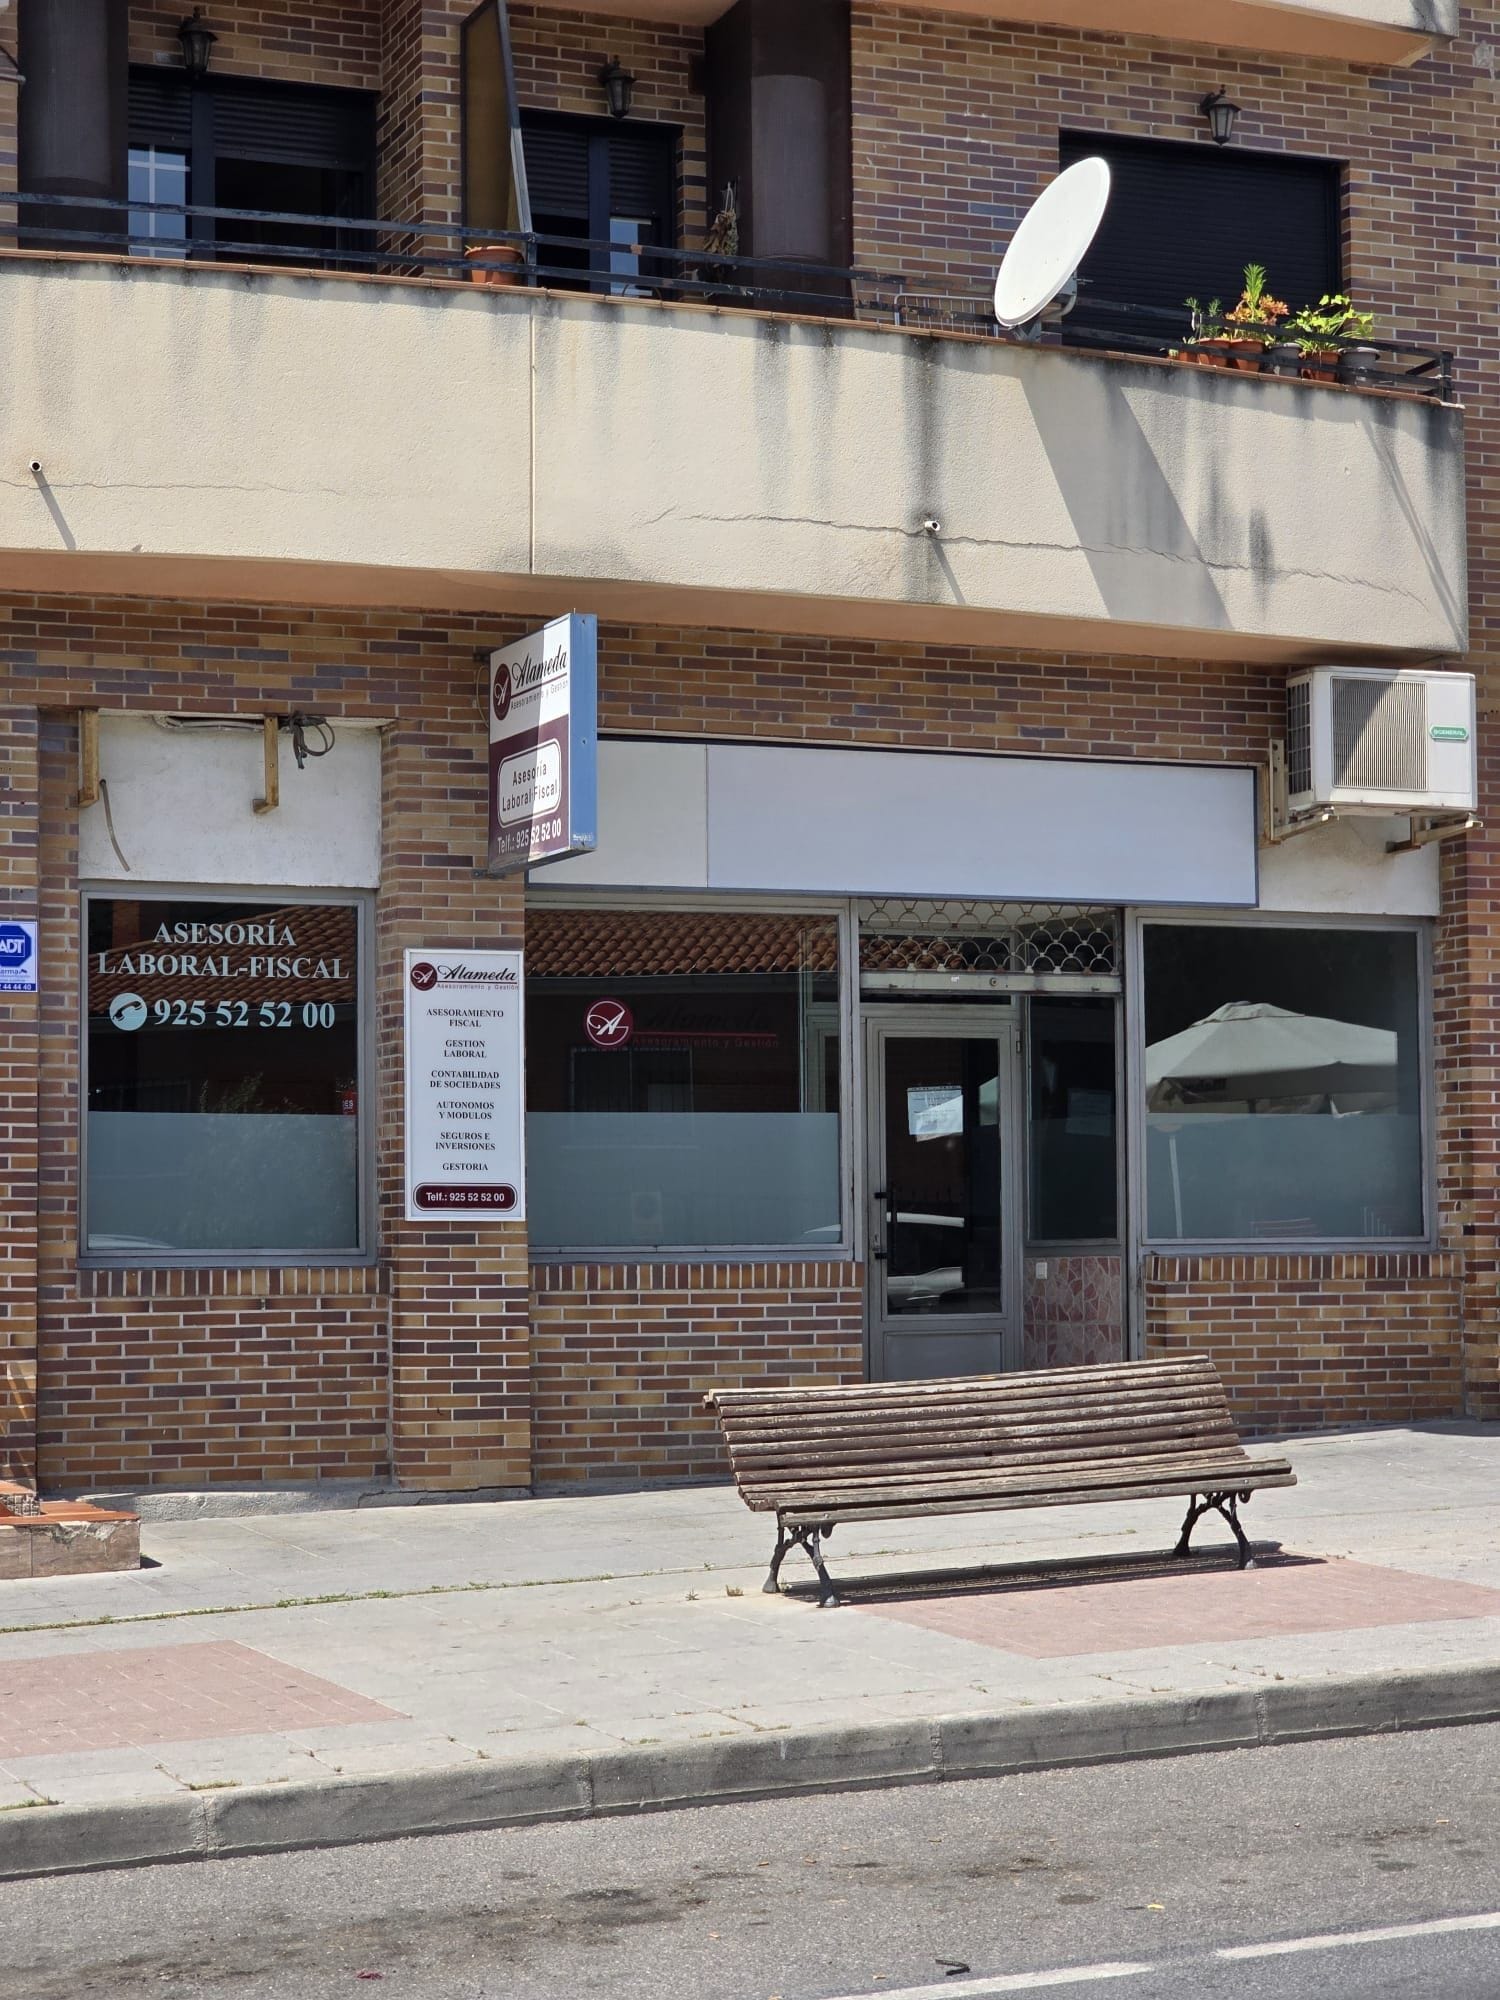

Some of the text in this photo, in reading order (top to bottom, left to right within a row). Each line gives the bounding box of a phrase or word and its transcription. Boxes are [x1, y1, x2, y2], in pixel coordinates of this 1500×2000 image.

[511, 644, 568, 689] Alameda
[512, 760, 547, 787] Asesoría
[497, 835, 515, 854] Telf.:
[516, 828, 529, 849] 925
[530, 824, 540, 845] 52
[541, 820, 550, 842] 52
[551, 818, 561, 838] 00
[152, 919, 297, 946] ASESORÍA
[0, 938, 25, 954] ADT
[97, 952, 350, 979] LABORAL-FISCAL
[437, 964, 517, 981] Alameda
[437, 983, 485, 991] Asesoramiento
[494, 983, 519, 991] Gestión
[154, 999, 336, 1029] 925 52 52 00
[426, 1008, 504, 1018] ASESORAMIENTO
[449, 1019, 482, 1028] FISCAL
[445, 1039, 486, 1048] GESTION
[444, 1050, 487, 1059] LABORAL
[431, 1069, 500, 1079] CONTABILIDAD
[430, 1080, 501, 1090] DE SOCIEDADES
[436, 1101, 495, 1110] AUTONOMOS
[438, 1111, 493, 1120] Y MODULOS
[440, 1131, 491, 1141] SEGUROS E
[435, 1142, 496, 1151] INVERSIONES
[442, 1162, 489, 1171] GESTORIA
[426, 1192, 505, 1202] Telf.: 925 52 52 00
